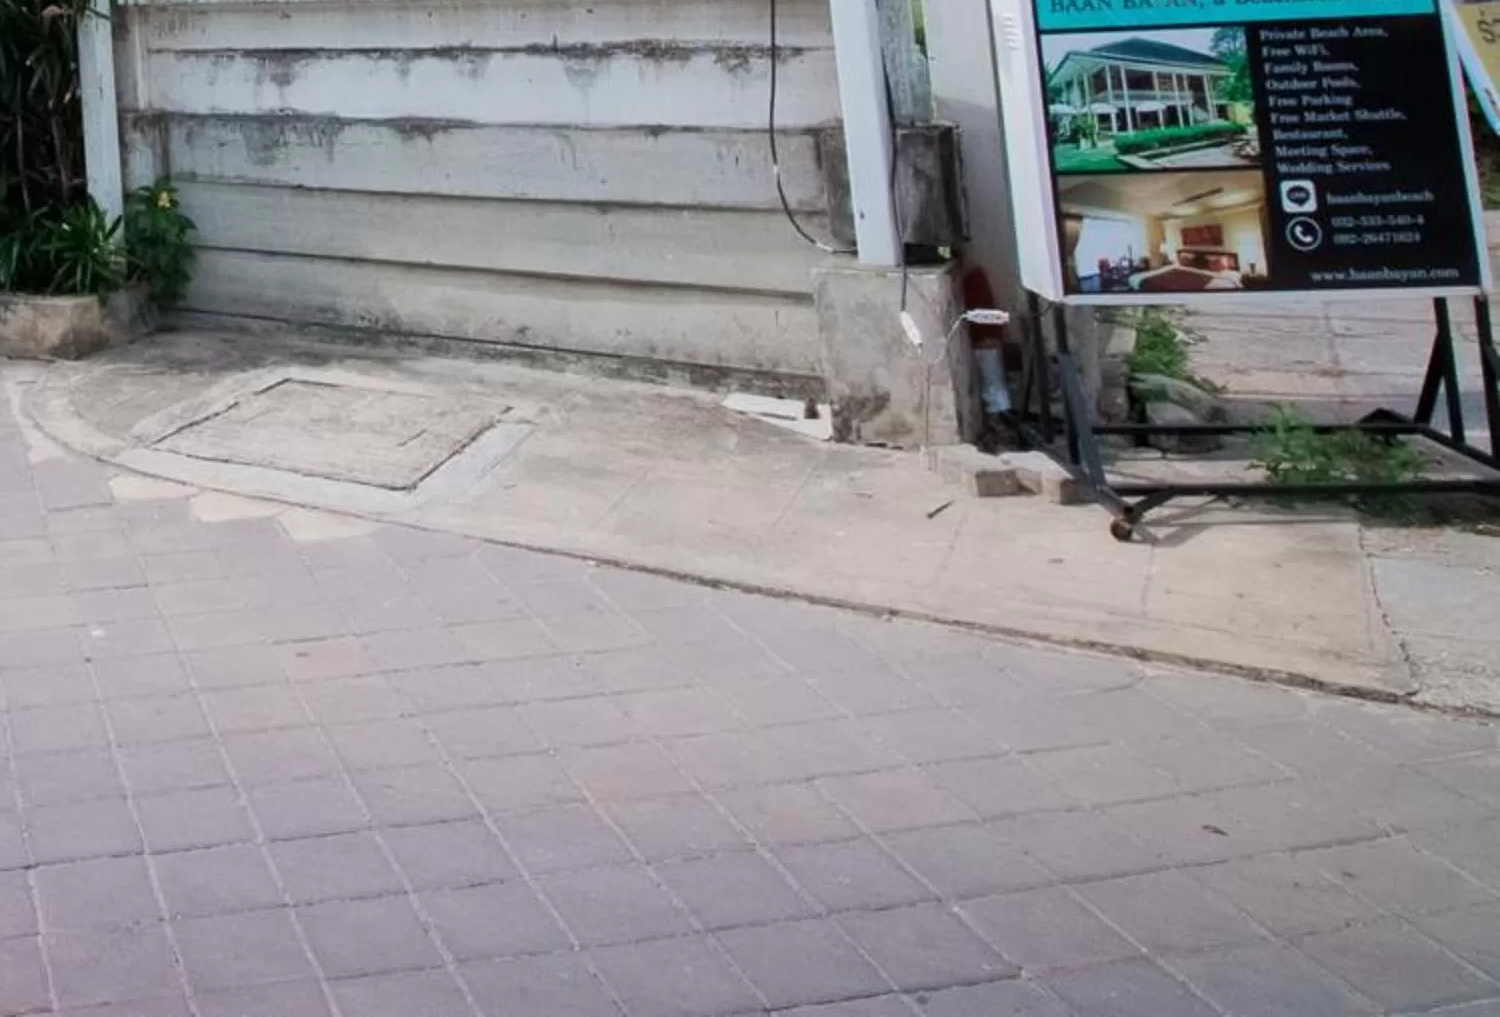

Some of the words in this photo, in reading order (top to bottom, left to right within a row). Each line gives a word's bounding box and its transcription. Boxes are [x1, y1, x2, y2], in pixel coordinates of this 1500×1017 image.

[1309, 25, 1350, 39] Beach
[1261, 44, 1292, 58] Free
[1263, 60, 1309, 75] Family
[1265, 77, 1318, 90] Outdoor
[1268, 94, 1298, 107] Free
[1270, 111, 1300, 124] Free
[1303, 109, 1350, 122] Market
[1275, 144, 1328, 158] Meeting
